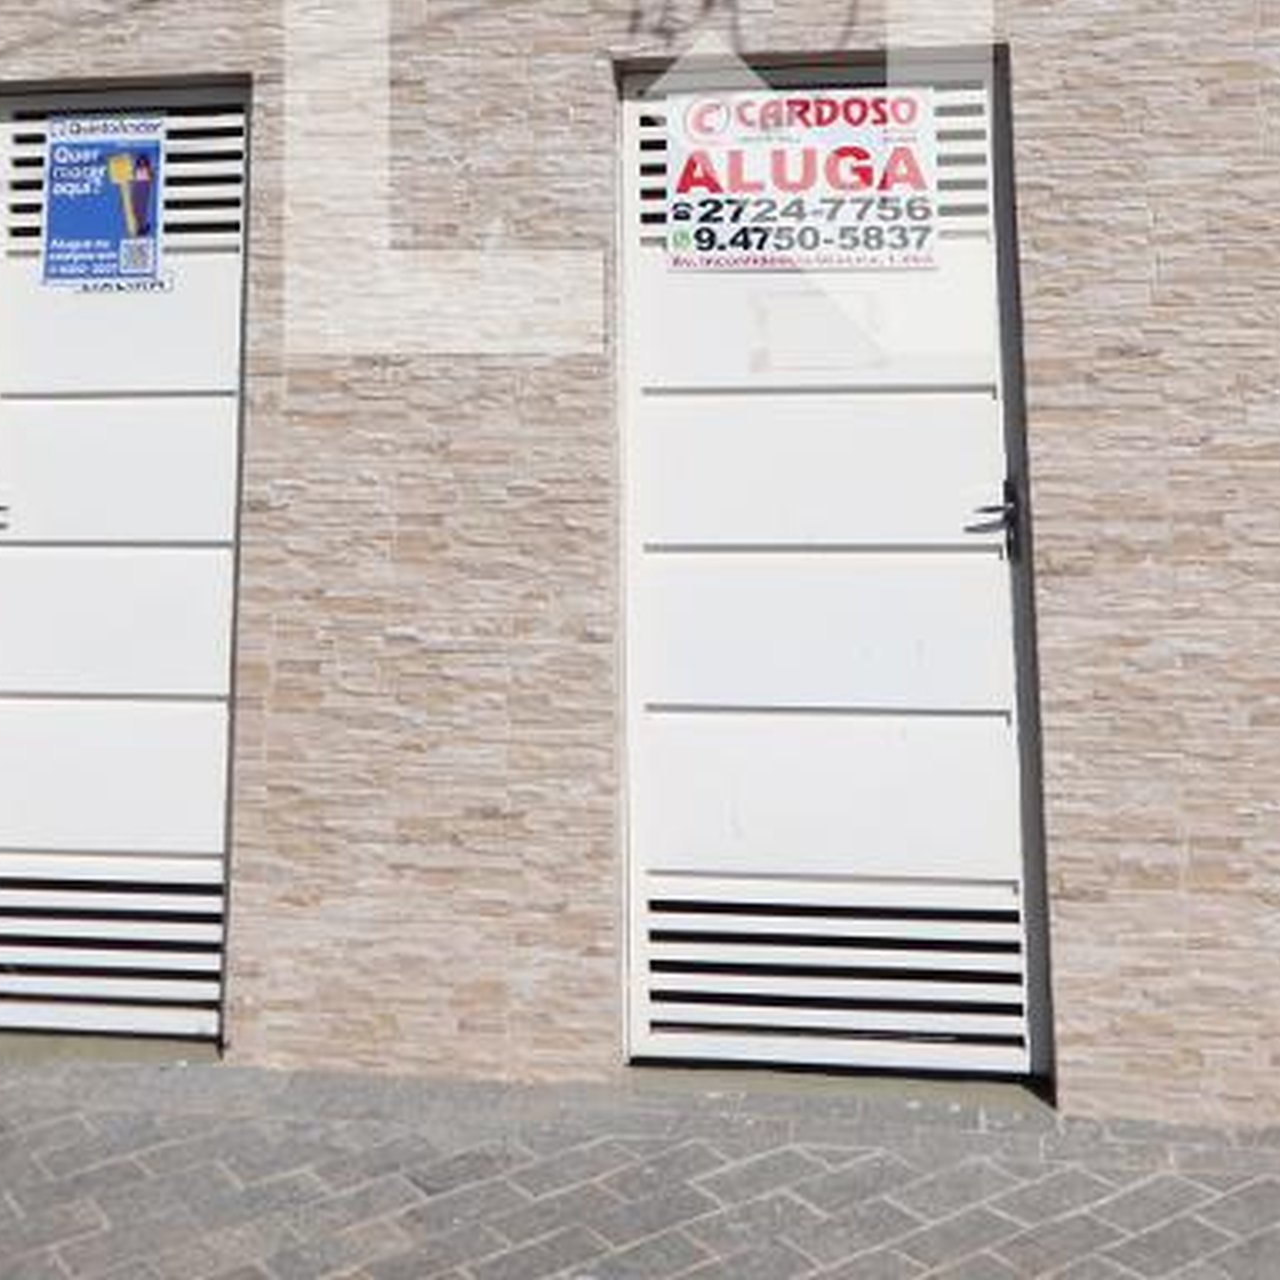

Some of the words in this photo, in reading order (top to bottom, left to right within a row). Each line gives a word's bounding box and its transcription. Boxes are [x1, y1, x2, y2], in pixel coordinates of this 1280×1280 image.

[734, 97, 919, 129] CARDOSO
[53, 146, 101, 163] Quer
[675, 146, 929, 194] ALUGA
[696, 198, 934, 223] 2724-7756
[693, 226, 934, 251] 9.4750-5837
